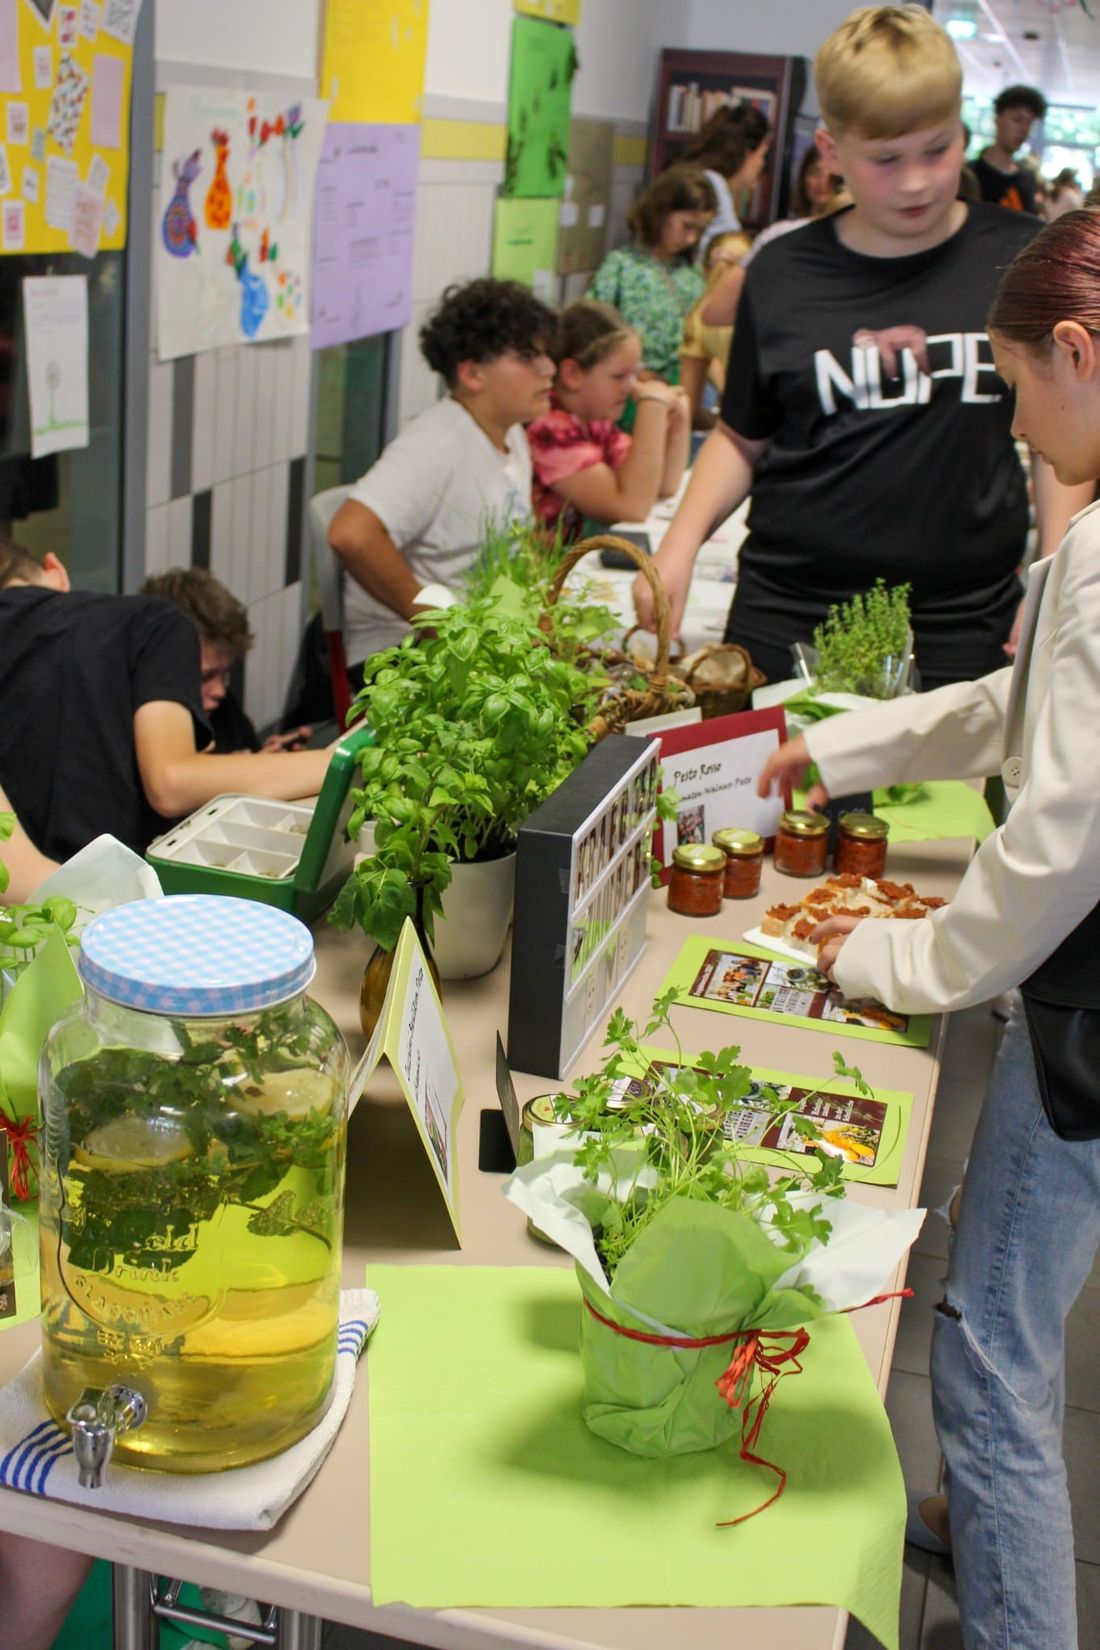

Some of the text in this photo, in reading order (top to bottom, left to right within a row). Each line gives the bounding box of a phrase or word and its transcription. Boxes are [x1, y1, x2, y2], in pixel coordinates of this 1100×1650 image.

[814, 332, 1002, 416] NOPE
[673, 762, 721, 788] Pesto Rosso
